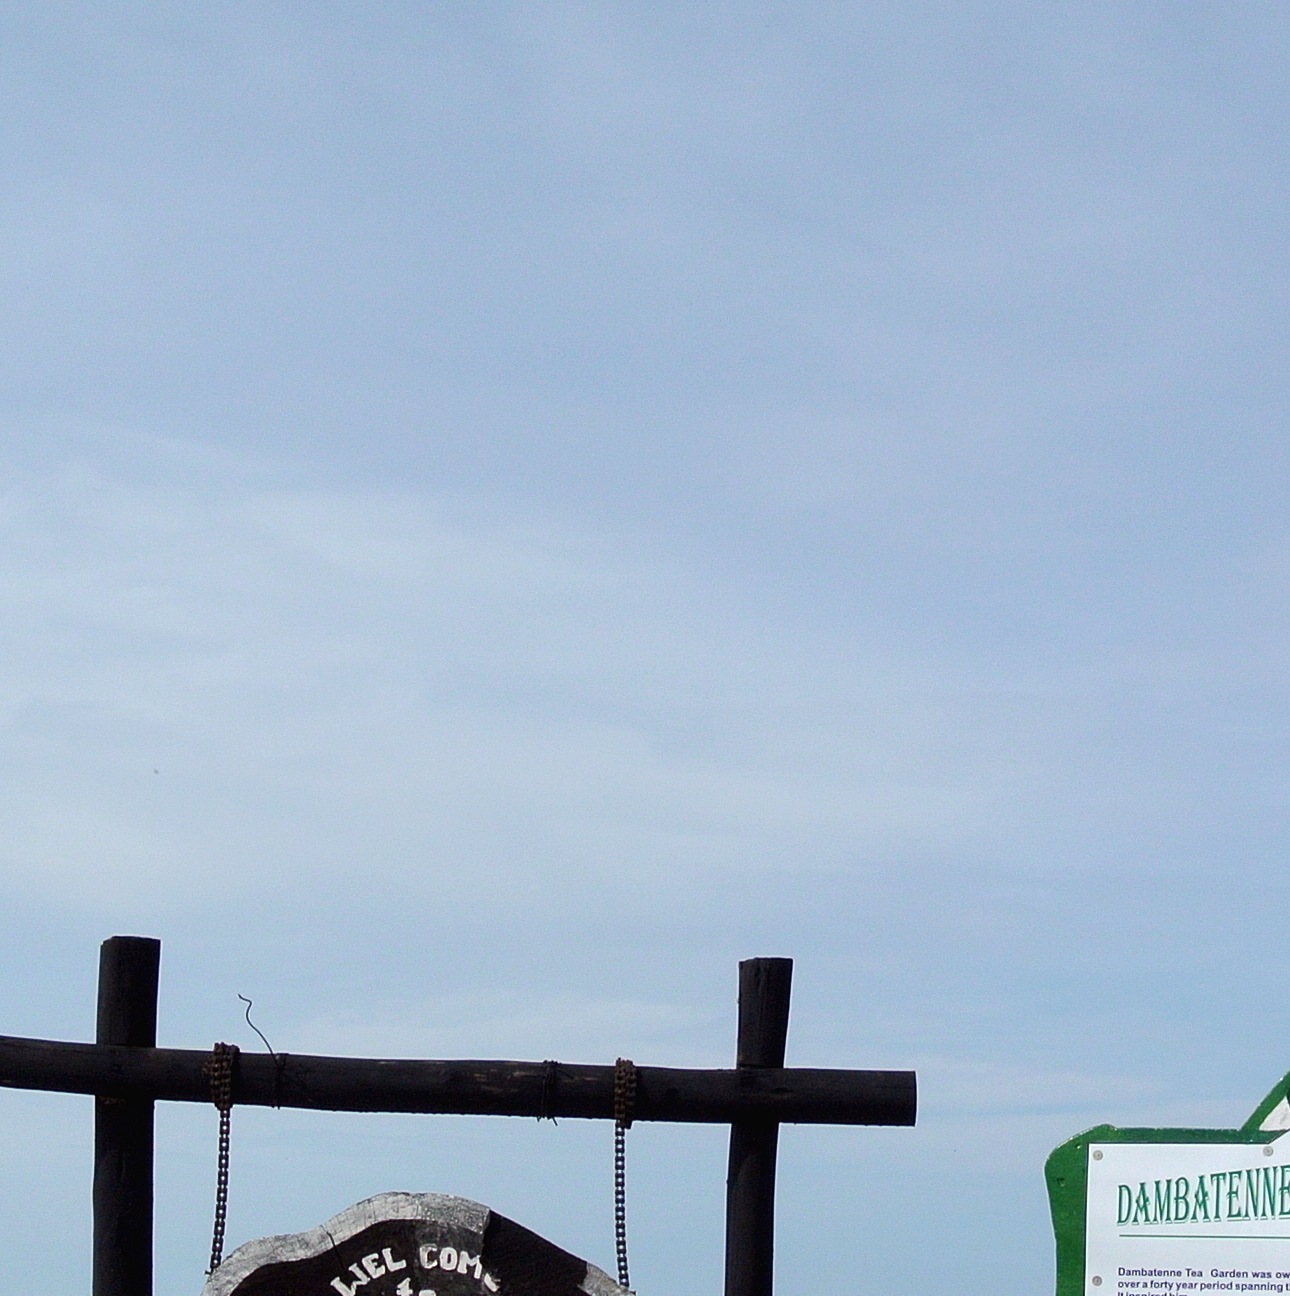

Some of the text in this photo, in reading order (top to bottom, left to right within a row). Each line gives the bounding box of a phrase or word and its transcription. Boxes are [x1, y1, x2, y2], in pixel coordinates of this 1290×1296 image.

[1118, 1266, 1182, 1277] Dambatenne
[1184, 1268, 1203, 1278] Tea
[1210, 1268, 1248, 1278] Garden
[1117, 1281, 1140, 1289] over
[1149, 1279, 1174, 1291] forty
[1175, 1282, 1198, 1291] year
[1199, 1280, 1233, 1292] period
[1234, 1281, 1283, 1293] spanning
